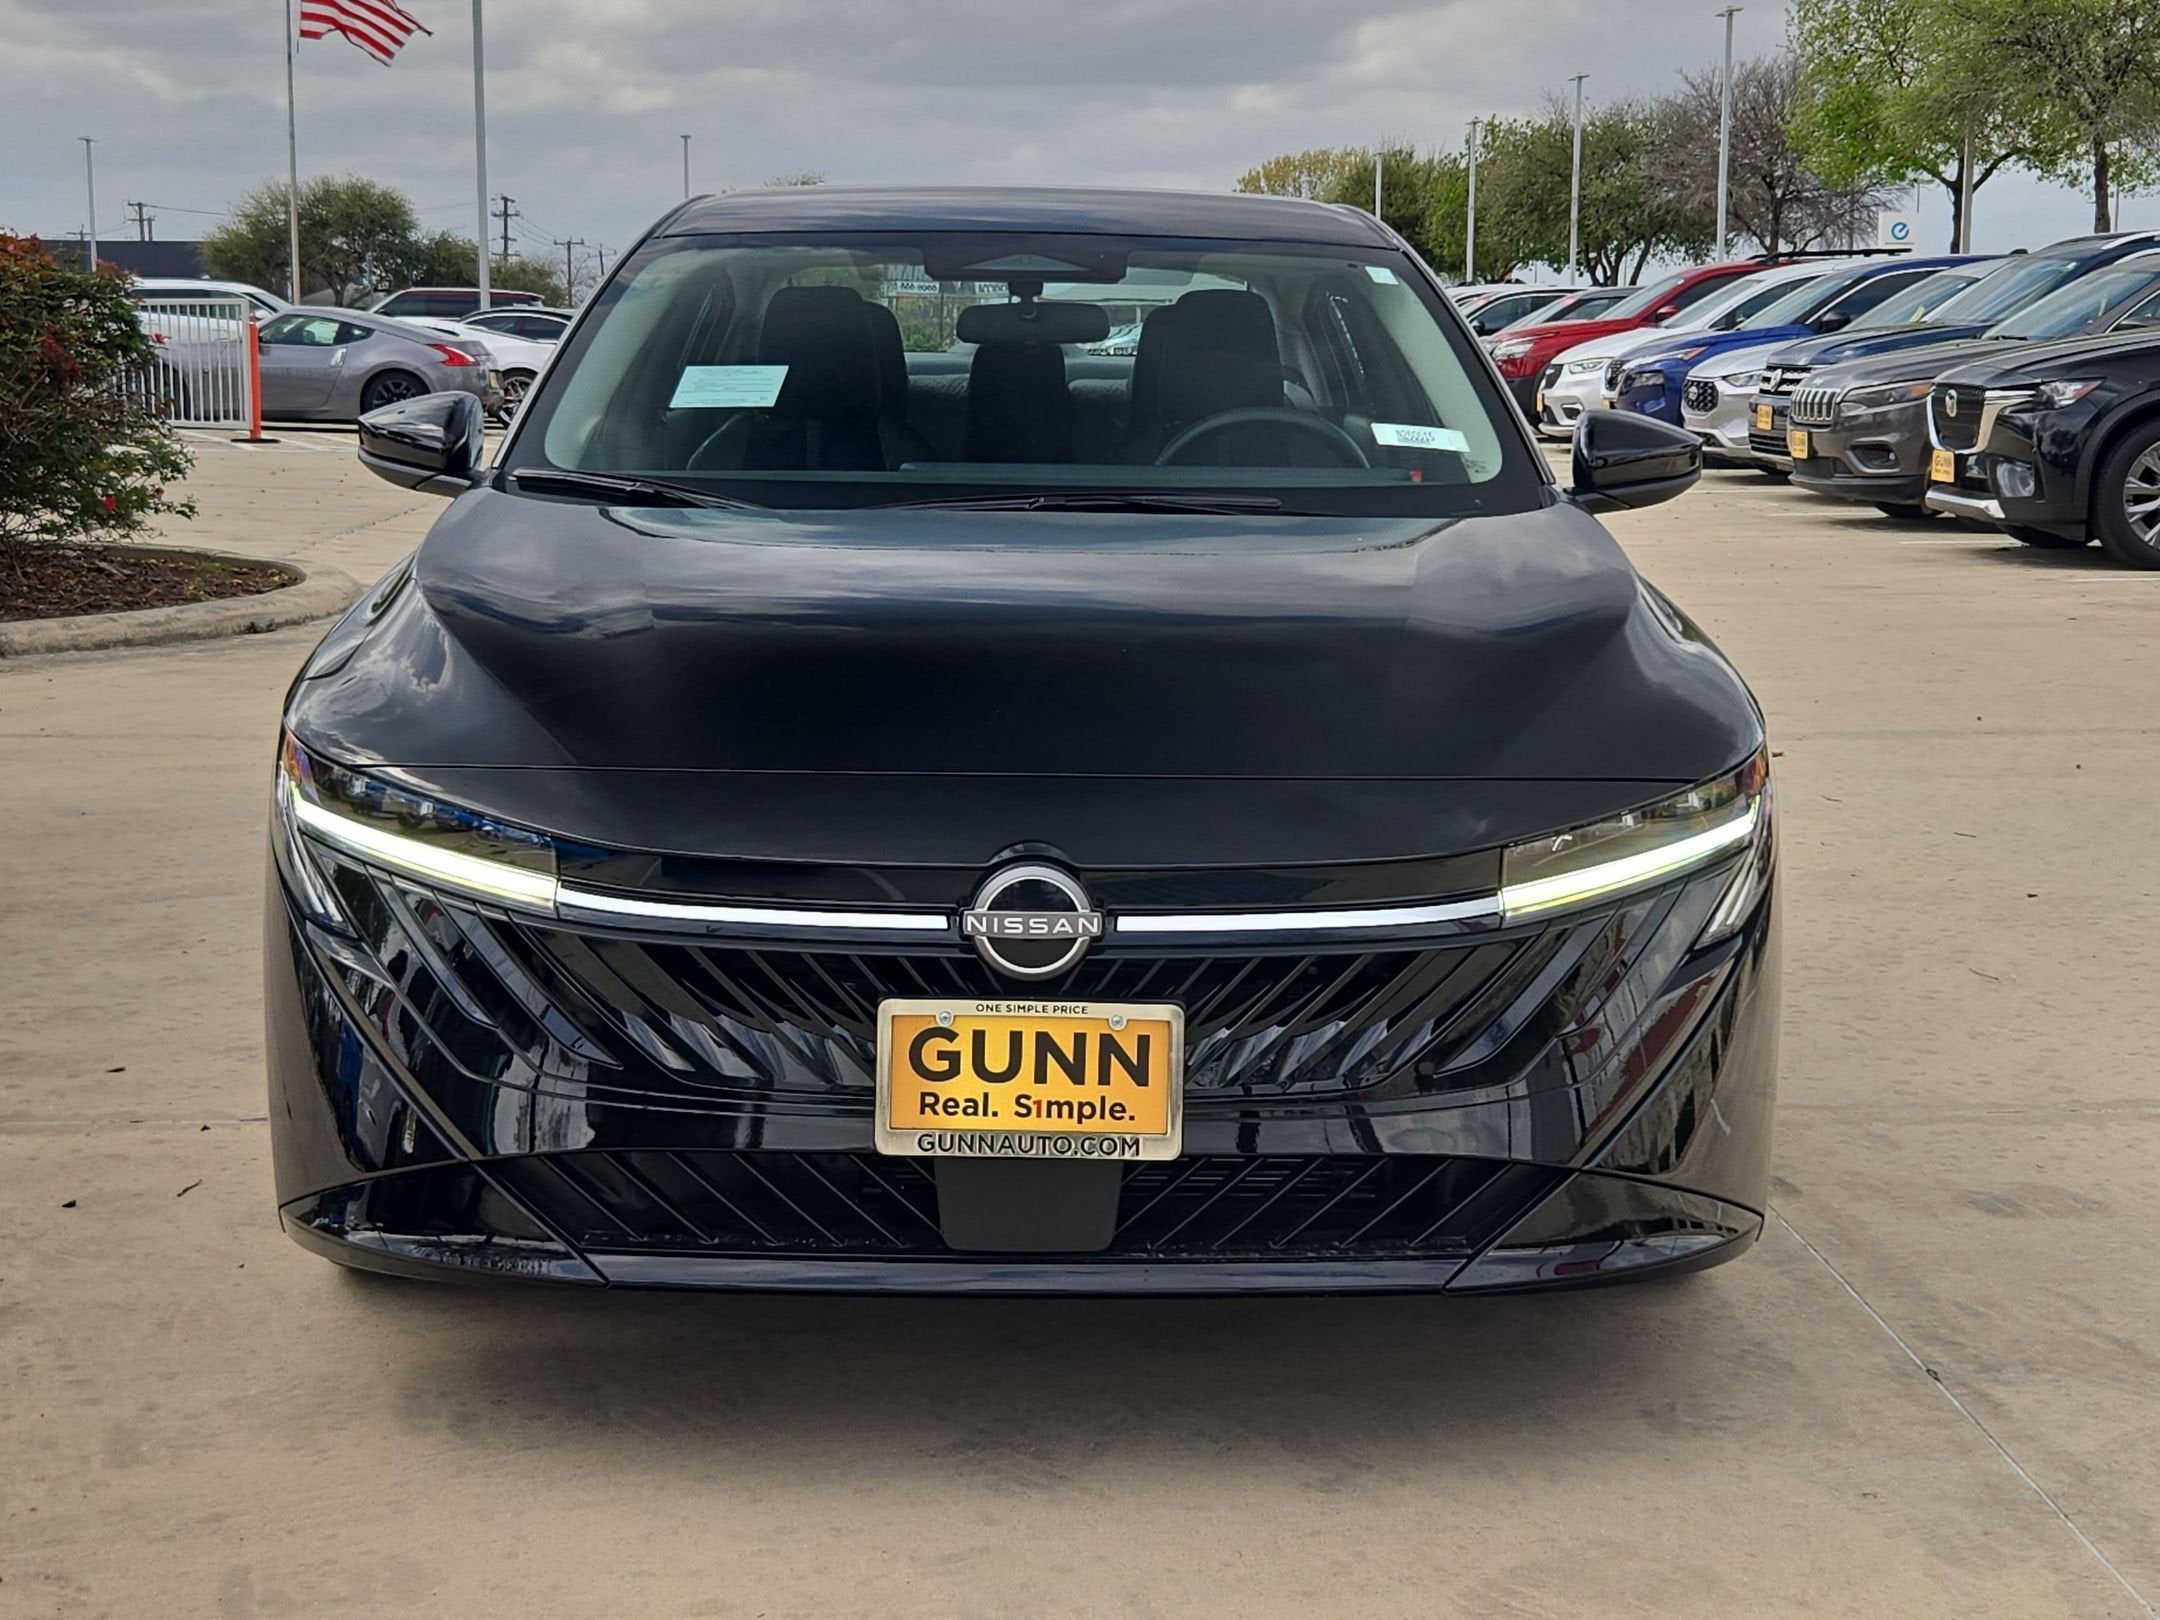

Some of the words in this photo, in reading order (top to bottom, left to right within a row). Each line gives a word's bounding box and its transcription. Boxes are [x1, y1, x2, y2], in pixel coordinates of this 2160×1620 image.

[967, 916, 1098, 934] NISSAN
[976, 1003, 1002, 1013] ONE
[1006, 1004, 1049, 1014] SIMPLE
[1053, 1005, 1088, 1015] PRICE
[908, 1026, 1151, 1087] GUNN
[919, 1091, 999, 1118] Real.
[917, 1133, 1140, 1157] GUNNAUTO.COM
